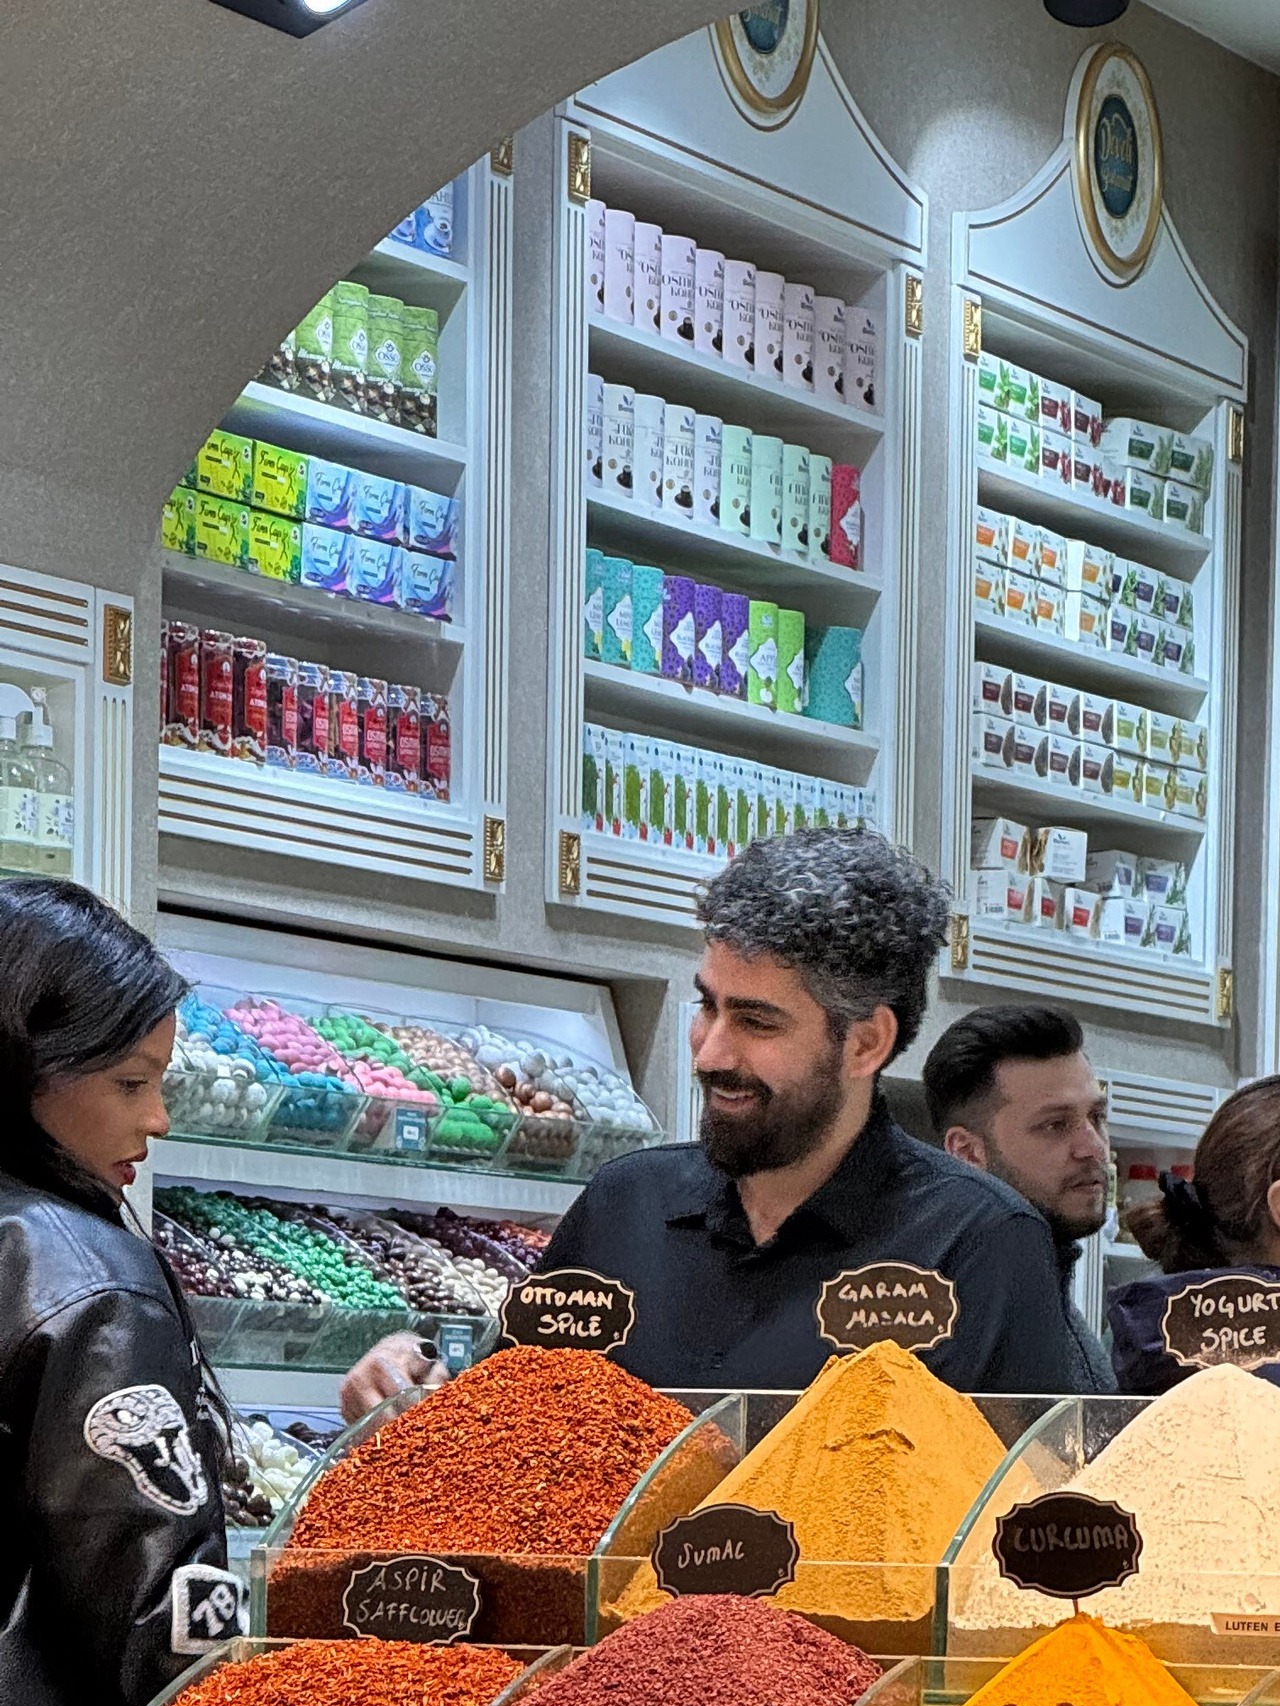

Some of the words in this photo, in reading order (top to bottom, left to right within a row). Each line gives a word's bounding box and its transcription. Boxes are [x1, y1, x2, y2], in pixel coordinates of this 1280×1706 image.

[520, 1285, 613, 1310] OTTOMAN
[838, 1280, 929, 1300] GARAM
[537, 1312, 603, 1338] SPICE
[846, 1307, 936, 1330] MASALA
[1200, 1325, 1267, 1354] SPICE
[1013, 1523, 1130, 1554] CURCUMA
[1225, 1621, 1269, 1632] LUTFEN
